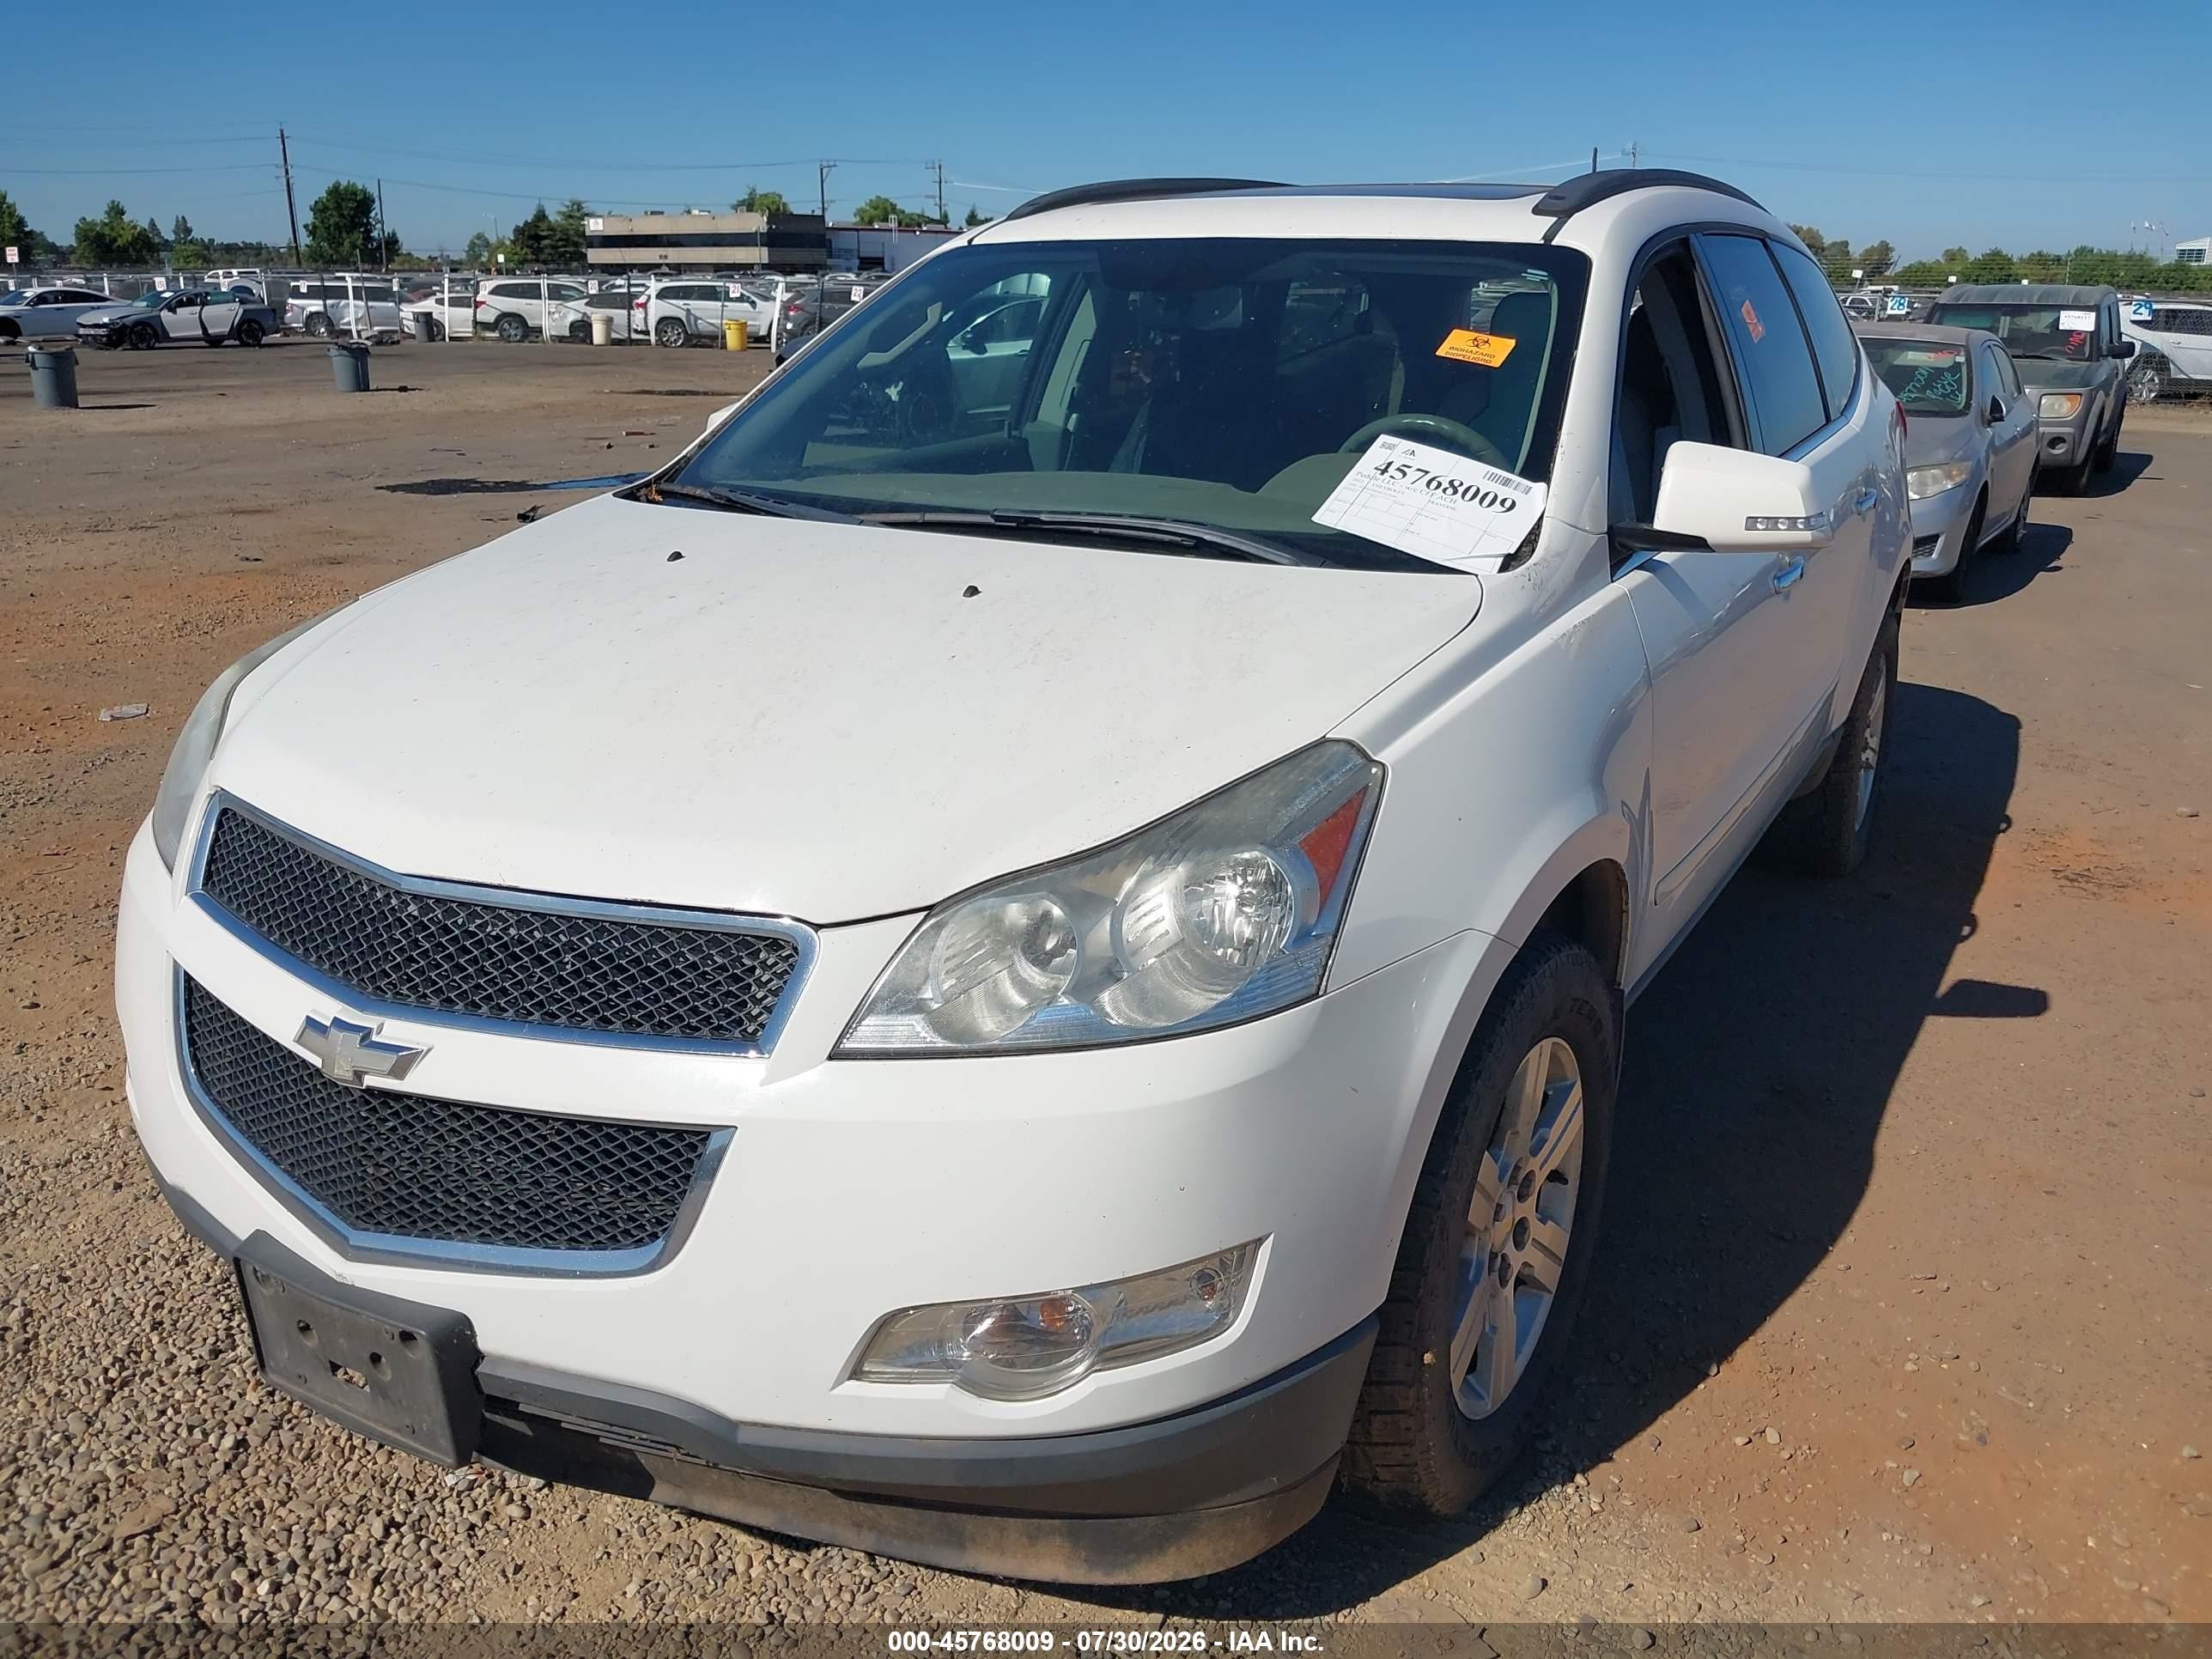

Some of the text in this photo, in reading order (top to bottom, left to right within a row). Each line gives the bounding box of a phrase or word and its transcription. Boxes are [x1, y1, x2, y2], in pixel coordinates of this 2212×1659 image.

[1890, 295, 1906, 311] 28
[2132, 301, 2154, 317] 29
[1444, 351, 1492, 364] BIOPELIGRO
[1449, 346, 1496, 359] BIOHAZARD
[1374, 460, 1516, 514] 45768009
